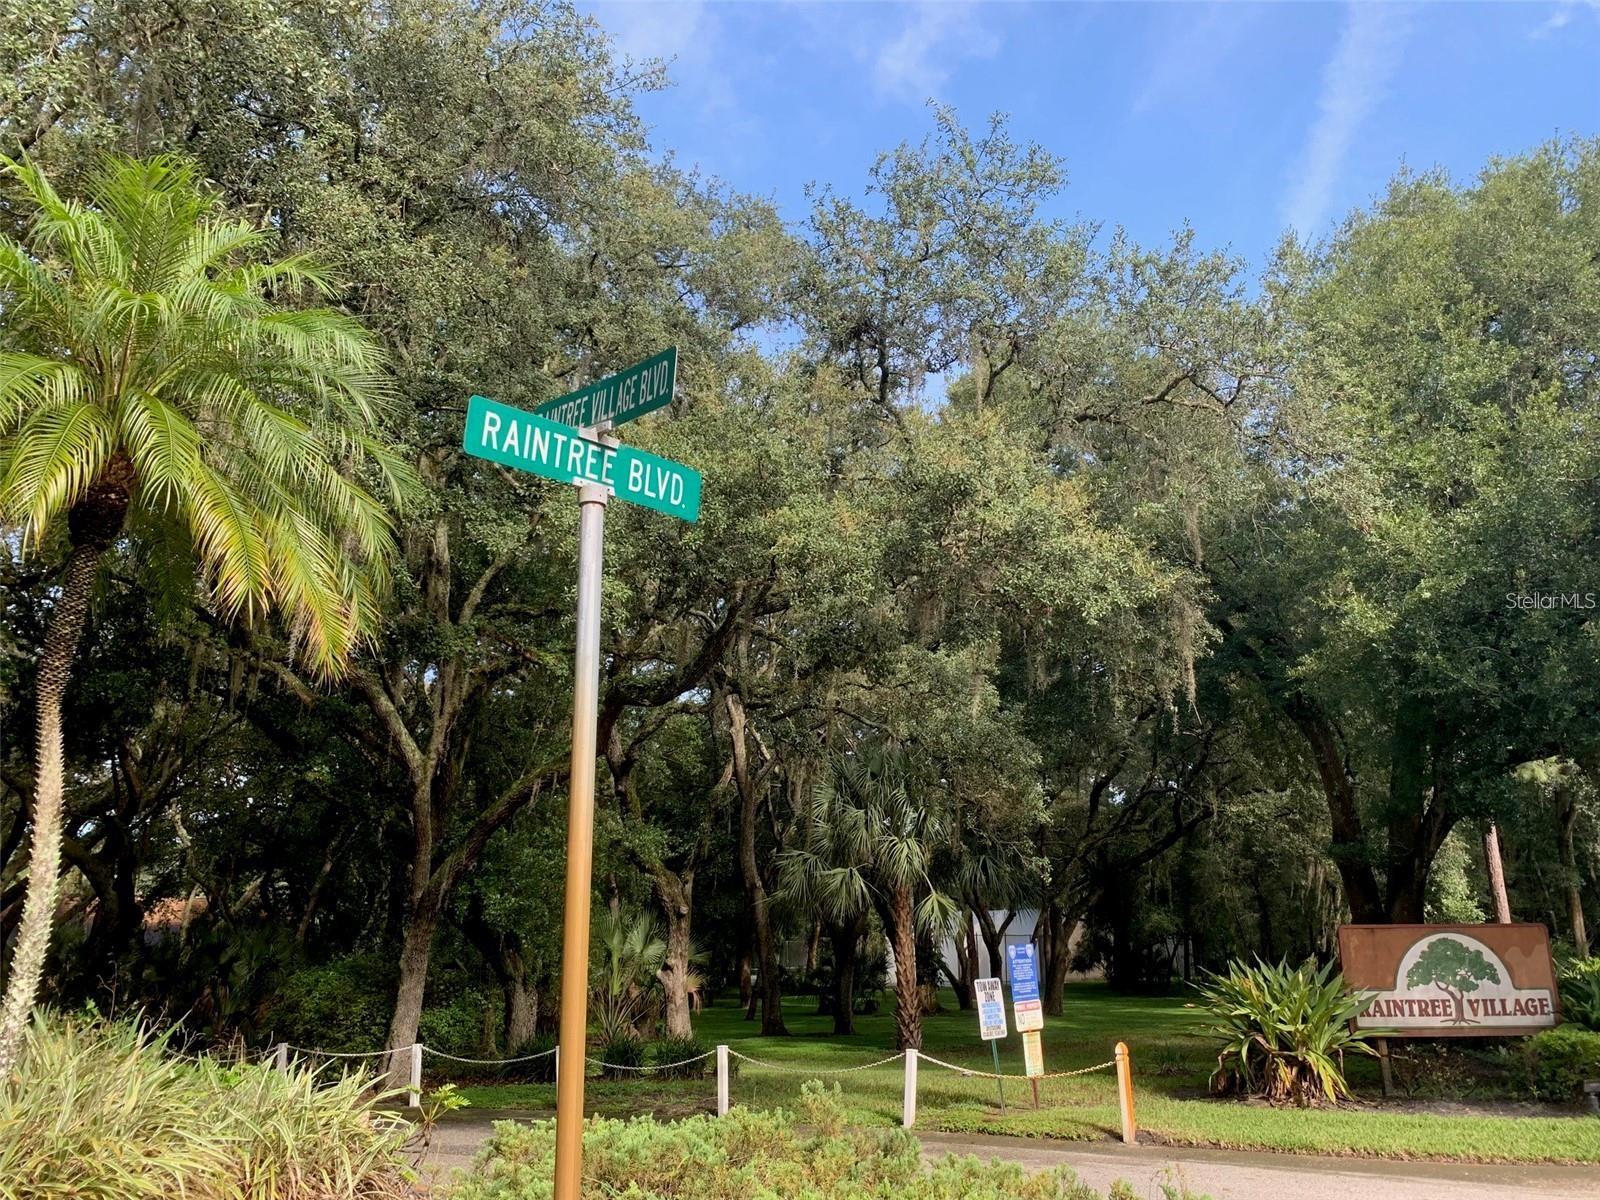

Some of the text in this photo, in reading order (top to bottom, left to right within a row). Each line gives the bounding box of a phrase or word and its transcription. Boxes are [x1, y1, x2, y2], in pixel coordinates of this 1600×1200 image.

[591, 374, 638, 425] VILLAGE
[639, 359, 669, 406] BLVD.
[481, 410, 686, 509] RAINTREE BLVD.
[976, 981, 987, 992] TOW
[984, 992, 996, 1002] ZONE
[1467, 997, 1551, 1017] VILLAGE
